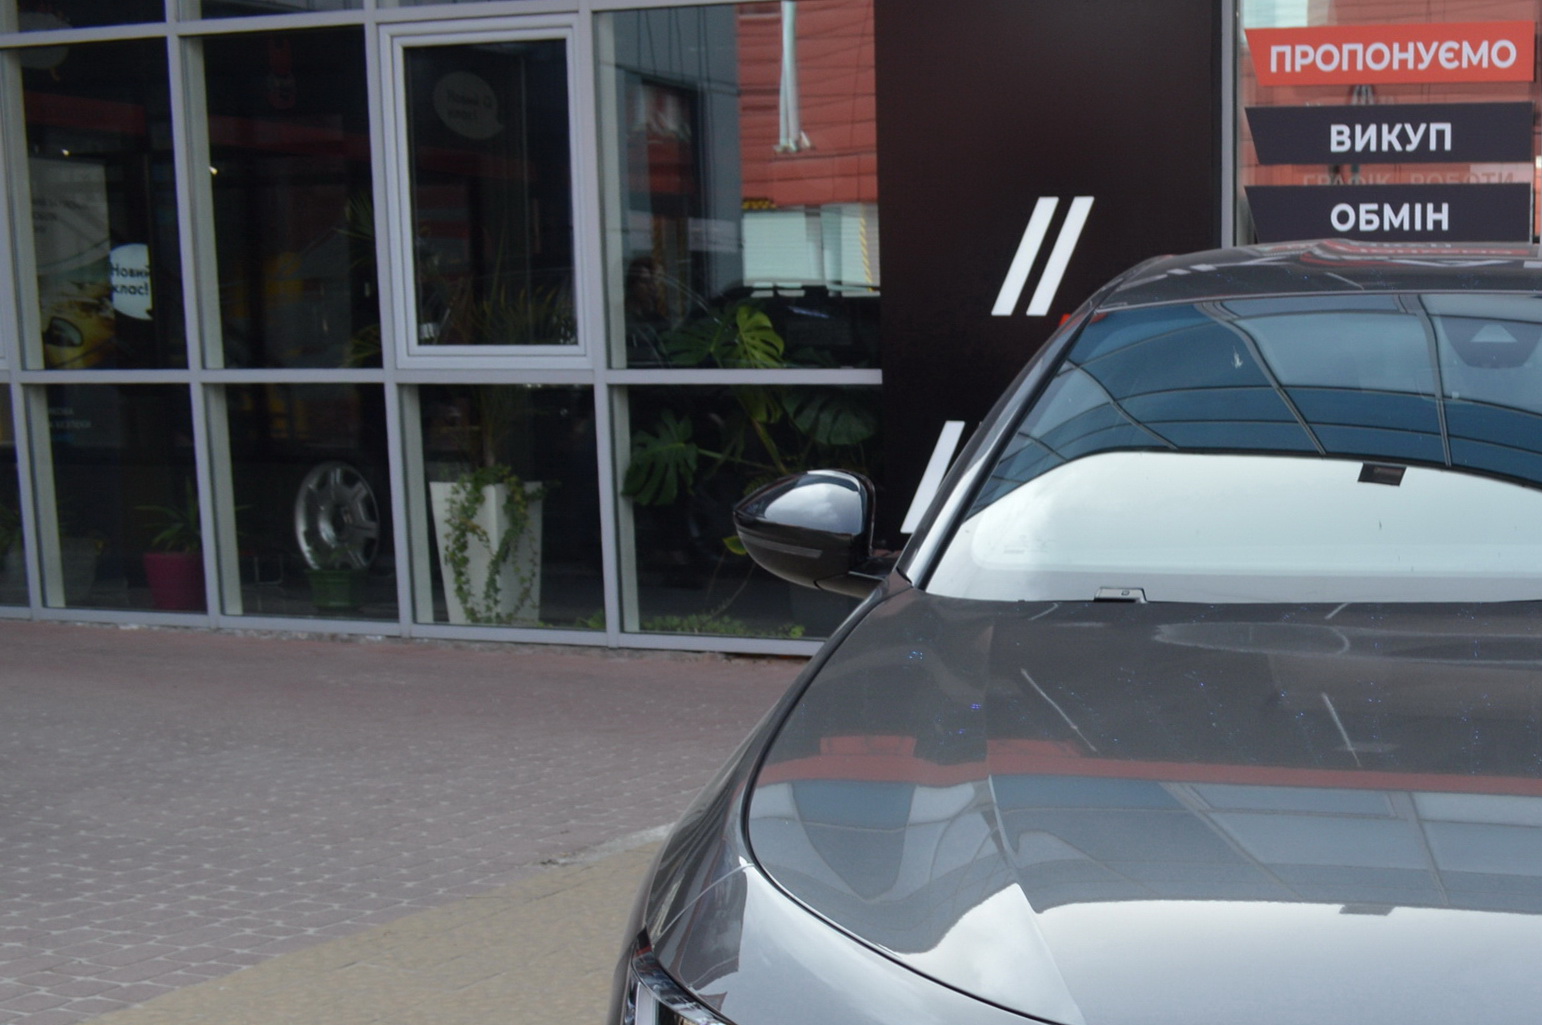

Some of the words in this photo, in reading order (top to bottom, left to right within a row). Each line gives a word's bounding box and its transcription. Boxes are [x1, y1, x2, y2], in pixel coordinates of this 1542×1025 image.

[1269, 39, 1518, 73] ПРОПОНУЄМО
[1329, 122, 1453, 153] ВИКУП
[1329, 202, 1450, 233] ОБМІН
